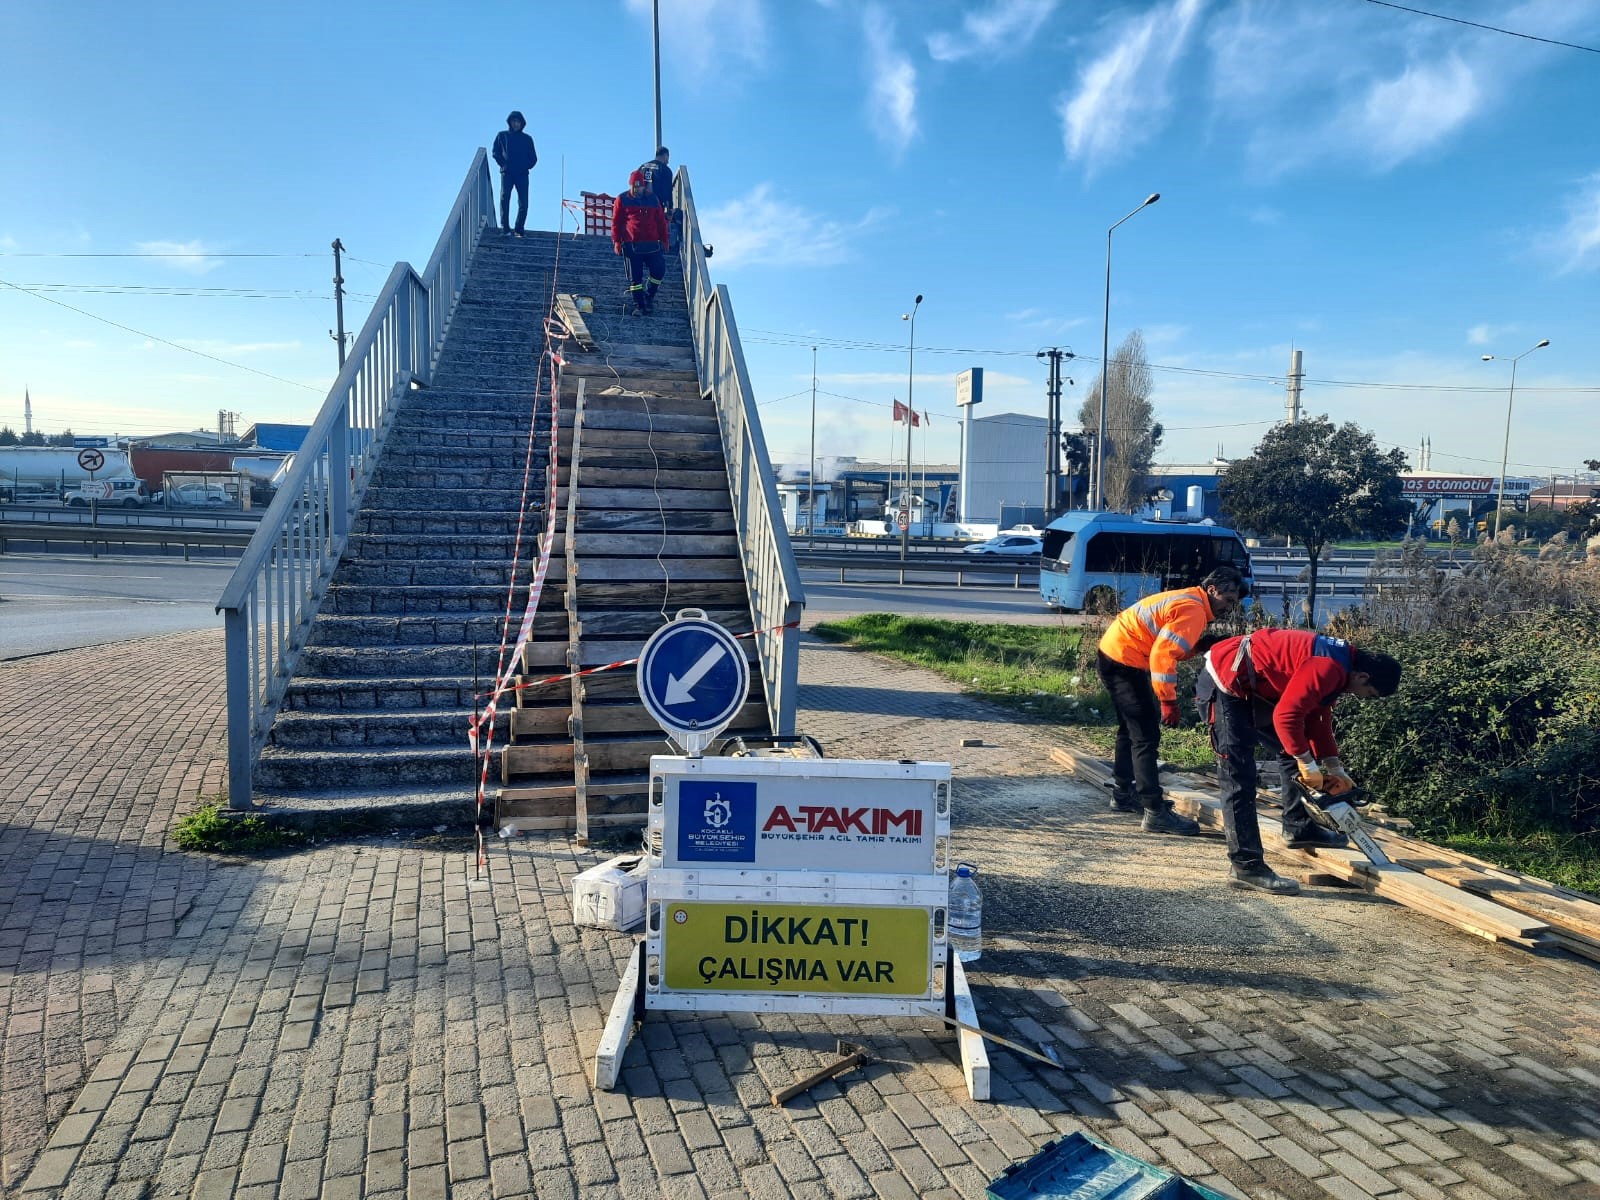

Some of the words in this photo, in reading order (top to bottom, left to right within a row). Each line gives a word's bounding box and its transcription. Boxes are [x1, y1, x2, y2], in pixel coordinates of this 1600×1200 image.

[762, 805, 923, 836] A-TAKIMI
[1360, 837, 1374, 853] STIHL
[725, 910, 869, 947] DİKKAT!
[699, 956, 829, 985] ÇALIŞMA
[836, 960, 895, 984] VAR
